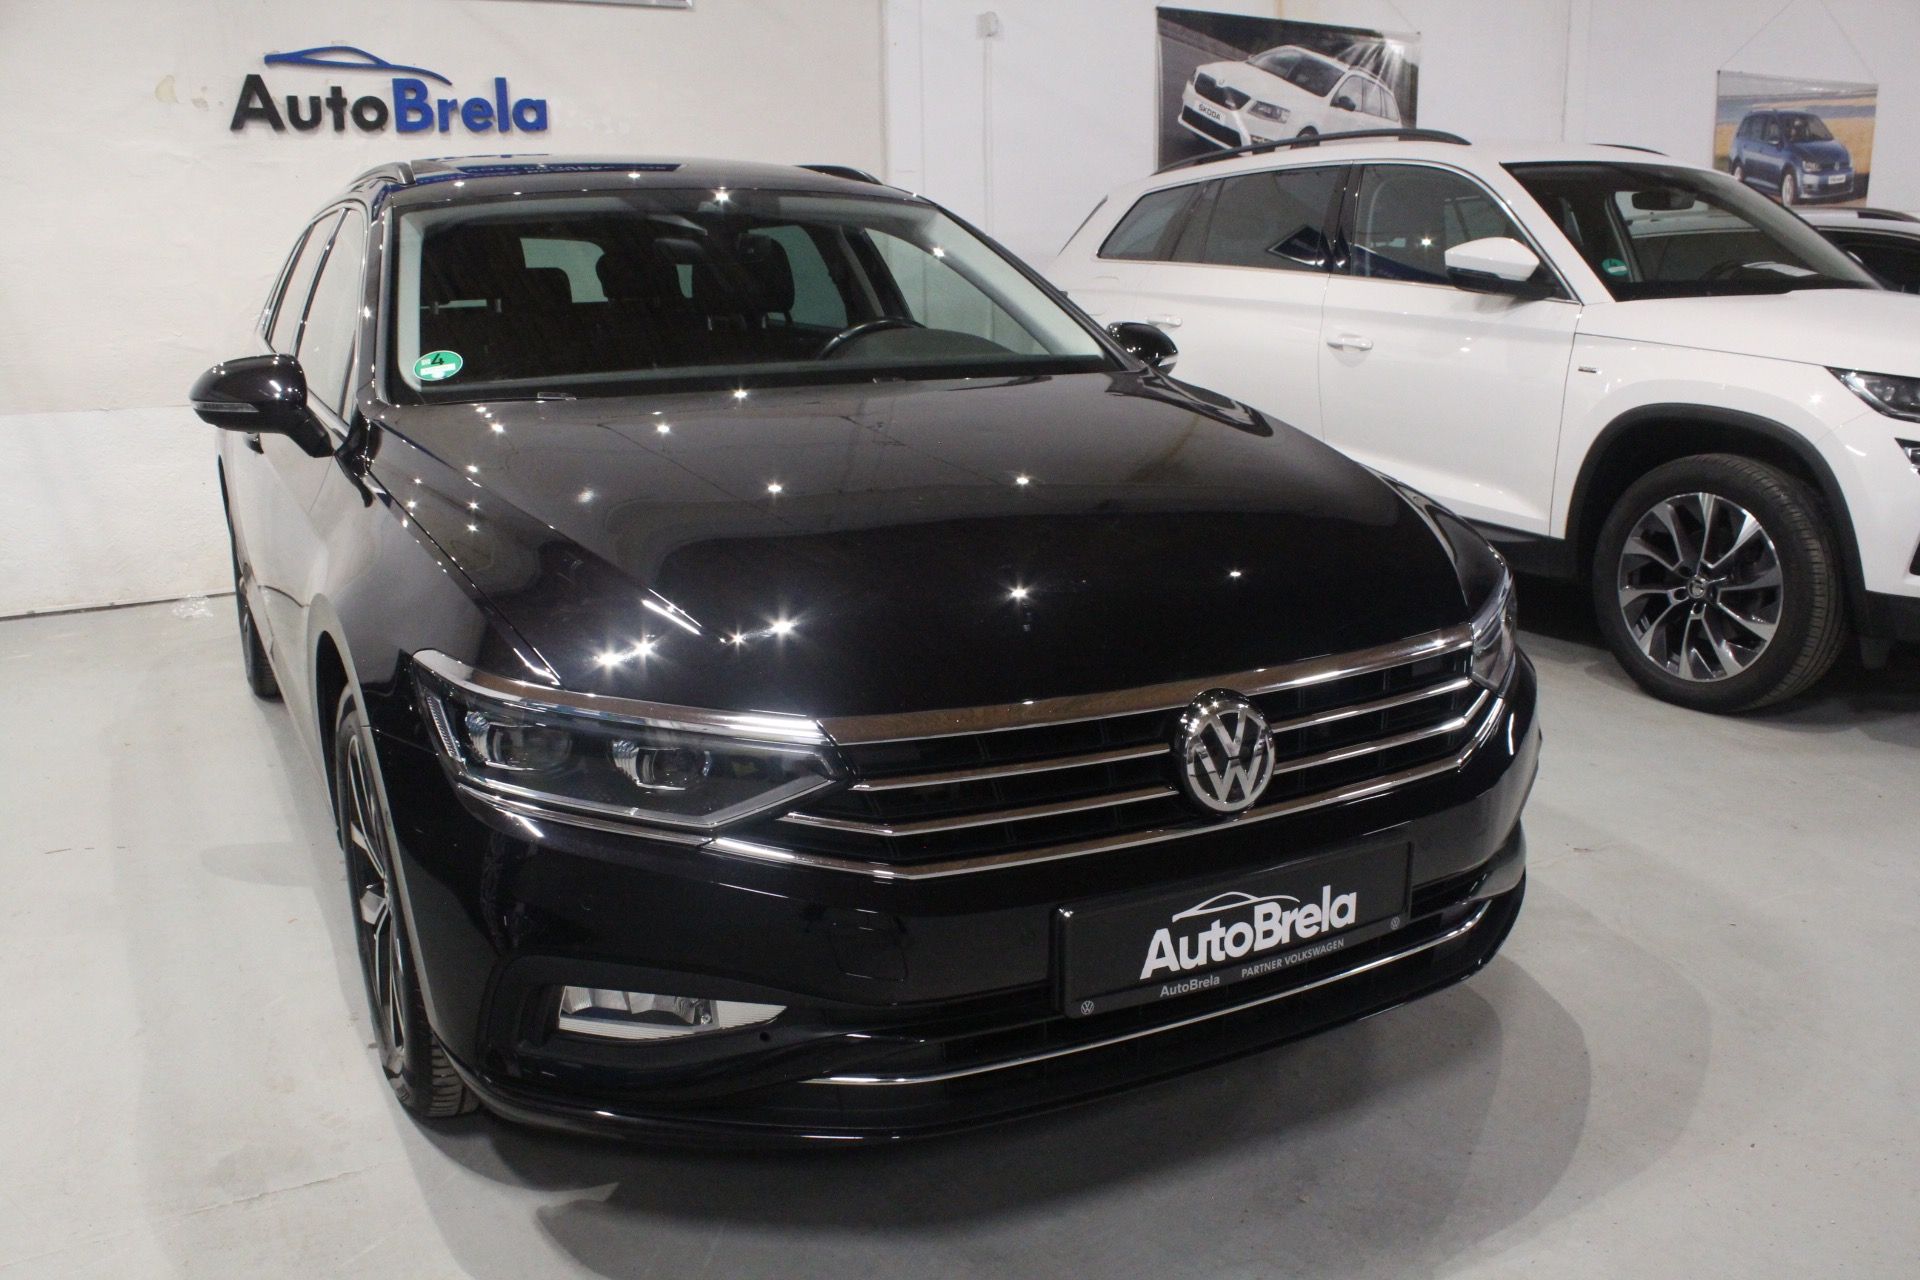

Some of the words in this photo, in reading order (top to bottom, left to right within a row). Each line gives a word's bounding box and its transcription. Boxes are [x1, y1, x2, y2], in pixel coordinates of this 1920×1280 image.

[230, 73, 548, 133] AutoBrela
[430, 352, 445, 365] 4
[1139, 884, 1358, 980] AutoBrela
[1160, 974, 1221, 997] AutoBrela
[1241, 957, 1283, 978] PARTNER
[1284, 938, 1345, 966] VOLKSWAGEN
